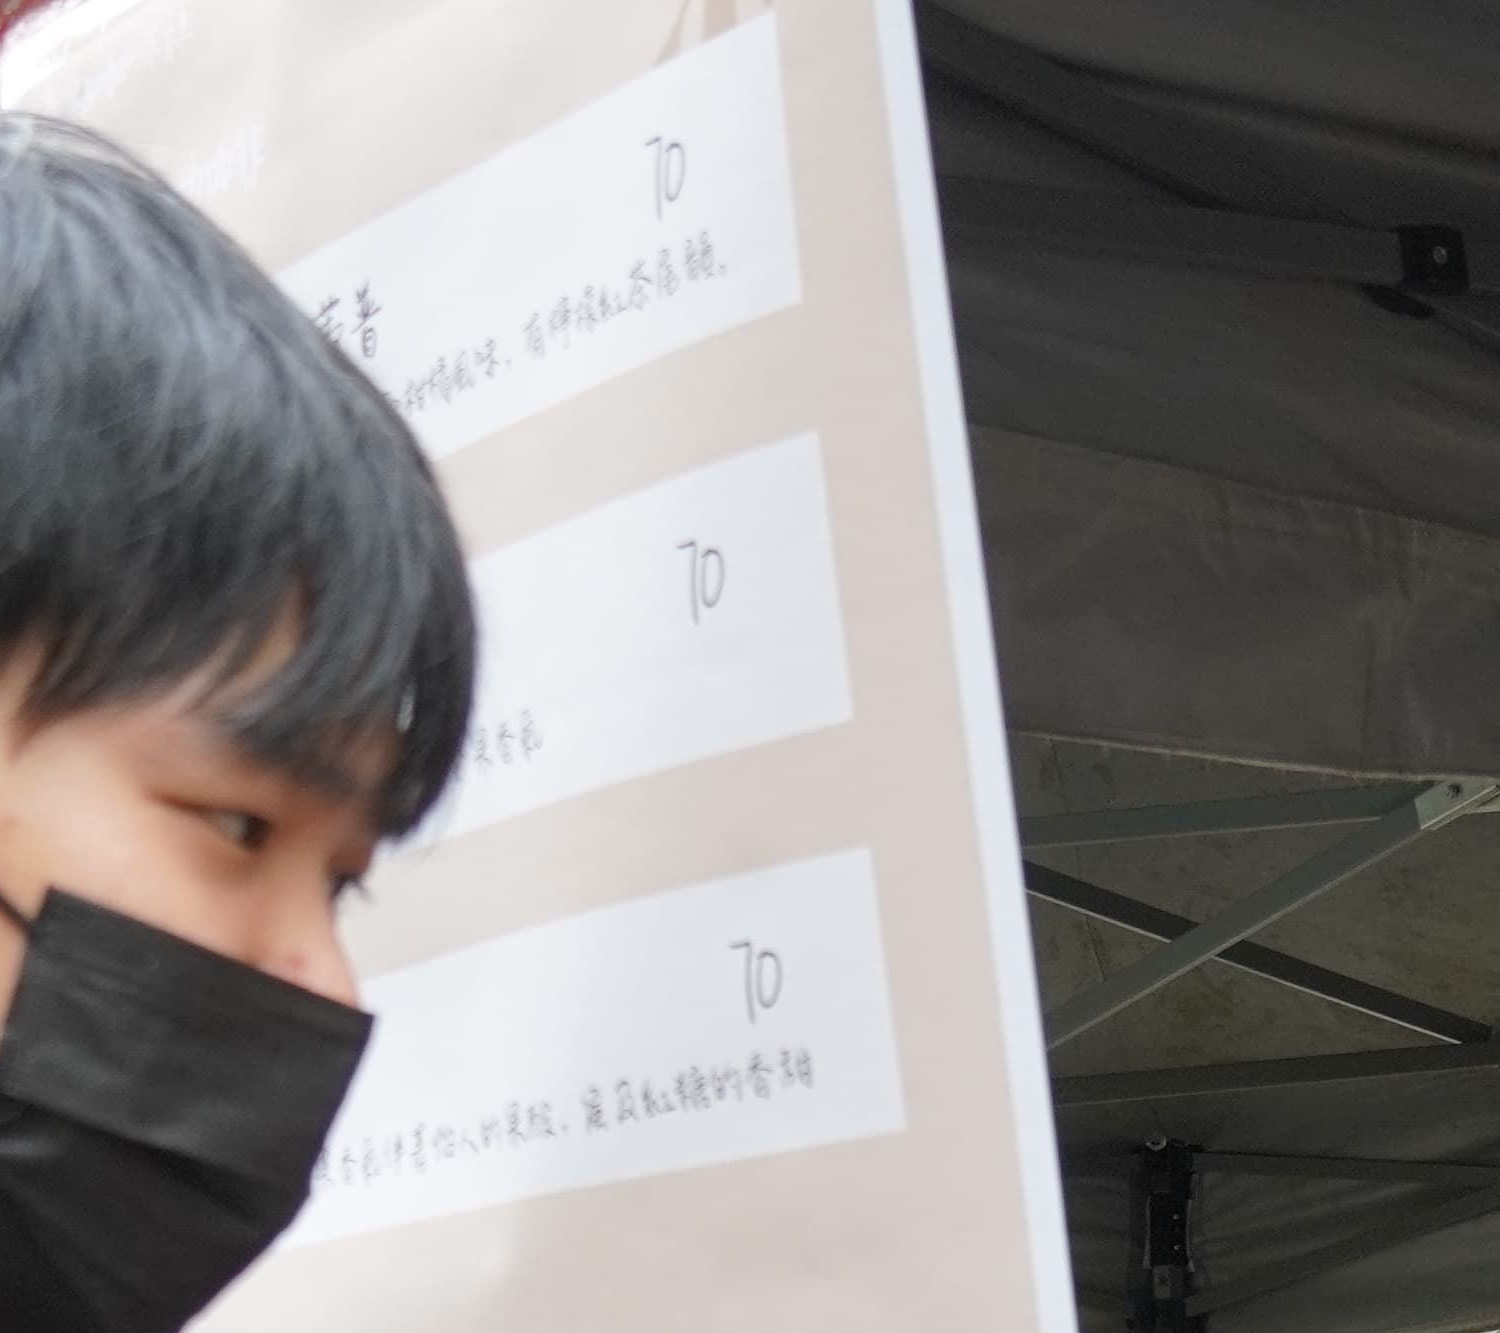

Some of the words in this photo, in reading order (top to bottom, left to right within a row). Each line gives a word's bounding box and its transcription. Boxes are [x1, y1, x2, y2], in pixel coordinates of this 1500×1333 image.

[643, 135, 686, 220] 70
[675, 538, 725, 626] 70
[728, 938, 783, 1024] 70
